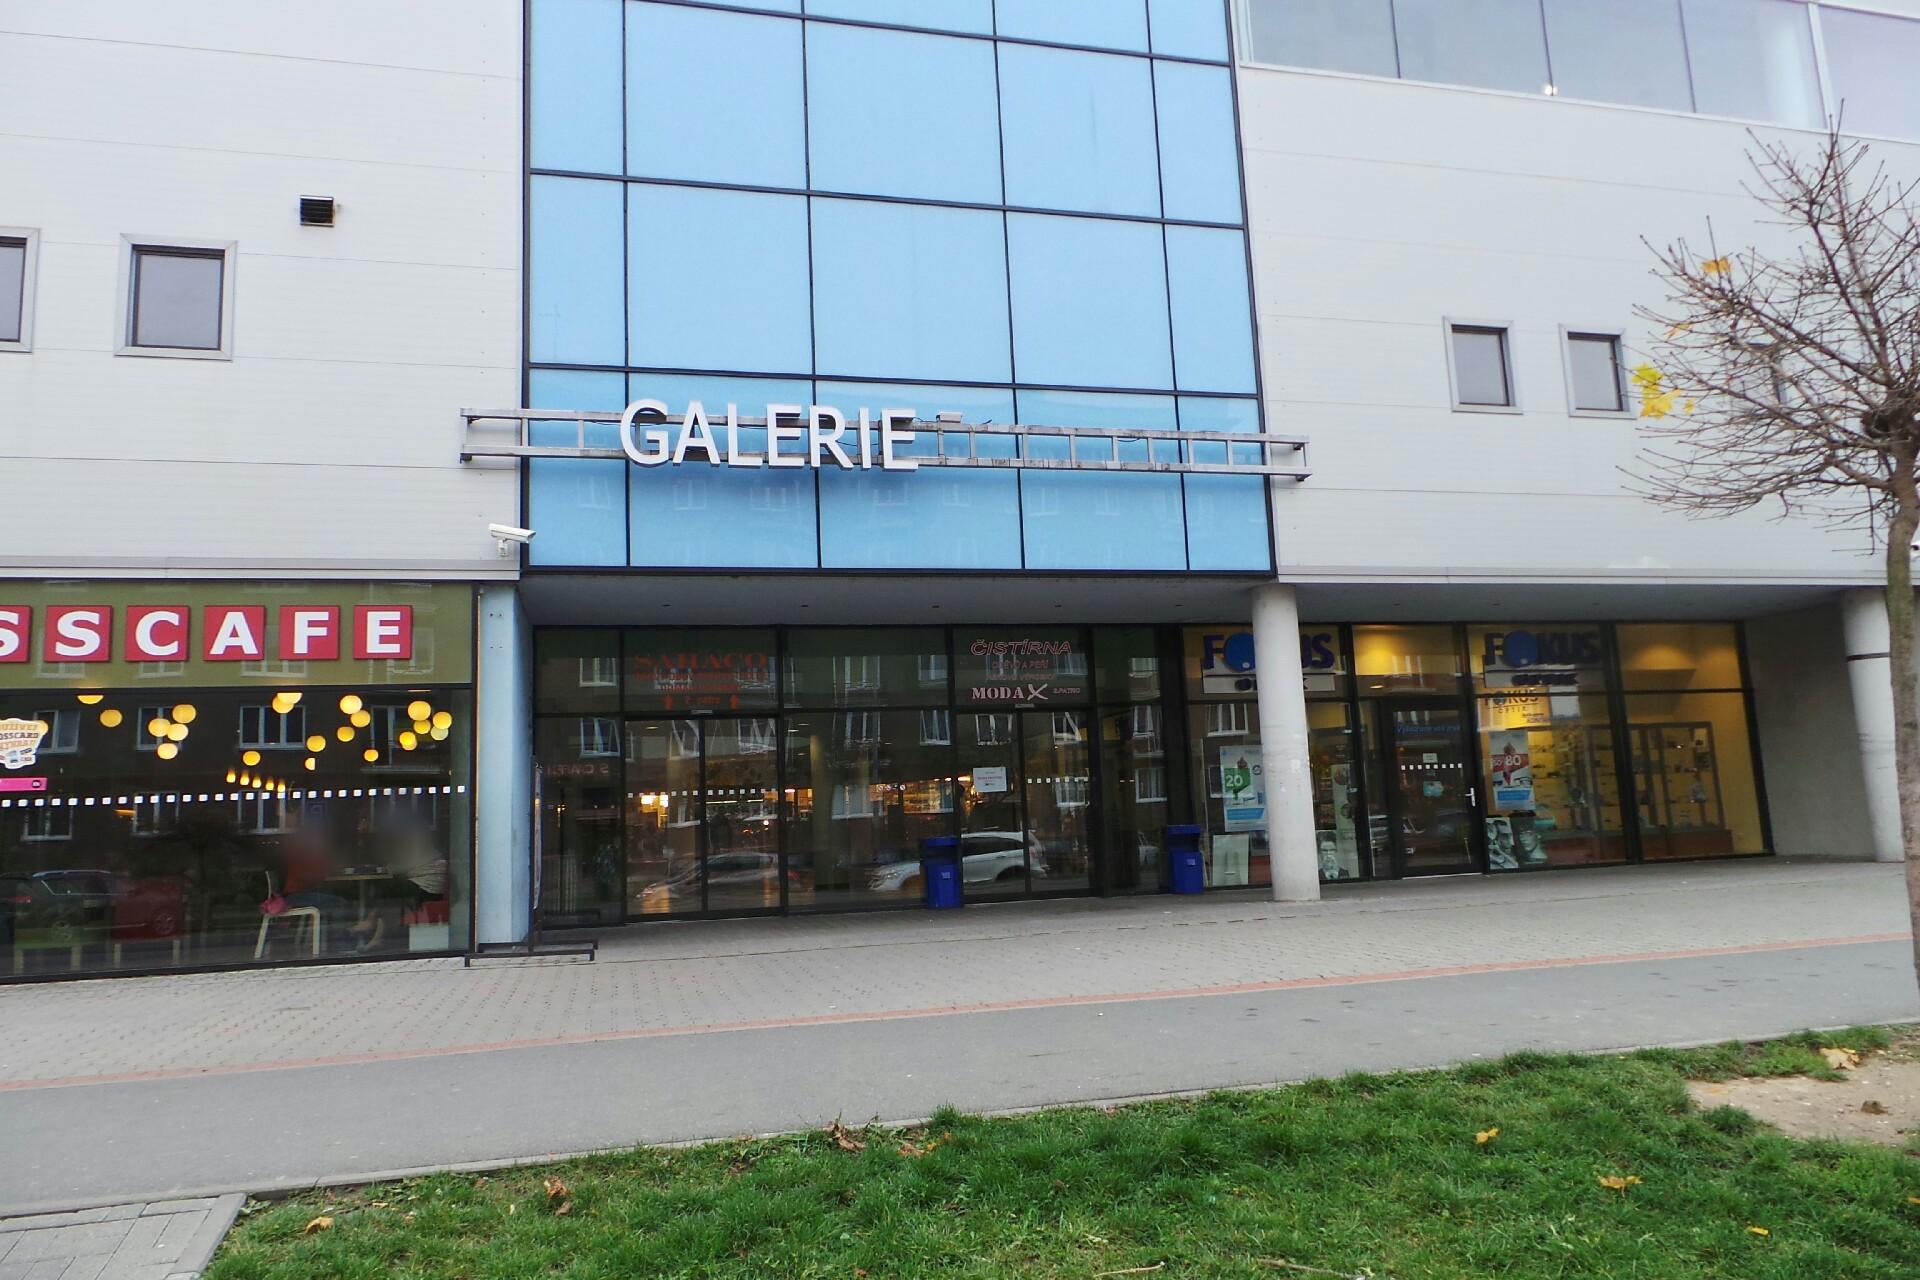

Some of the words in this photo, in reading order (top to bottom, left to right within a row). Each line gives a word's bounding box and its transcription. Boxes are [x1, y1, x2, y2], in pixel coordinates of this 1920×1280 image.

[619, 401, 918, 471] GALERIE
[970, 638, 1072, 656] ČISTÍRNA
[1505, 754, 1522, 766] 80
[1225, 774, 1243, 787] 20
